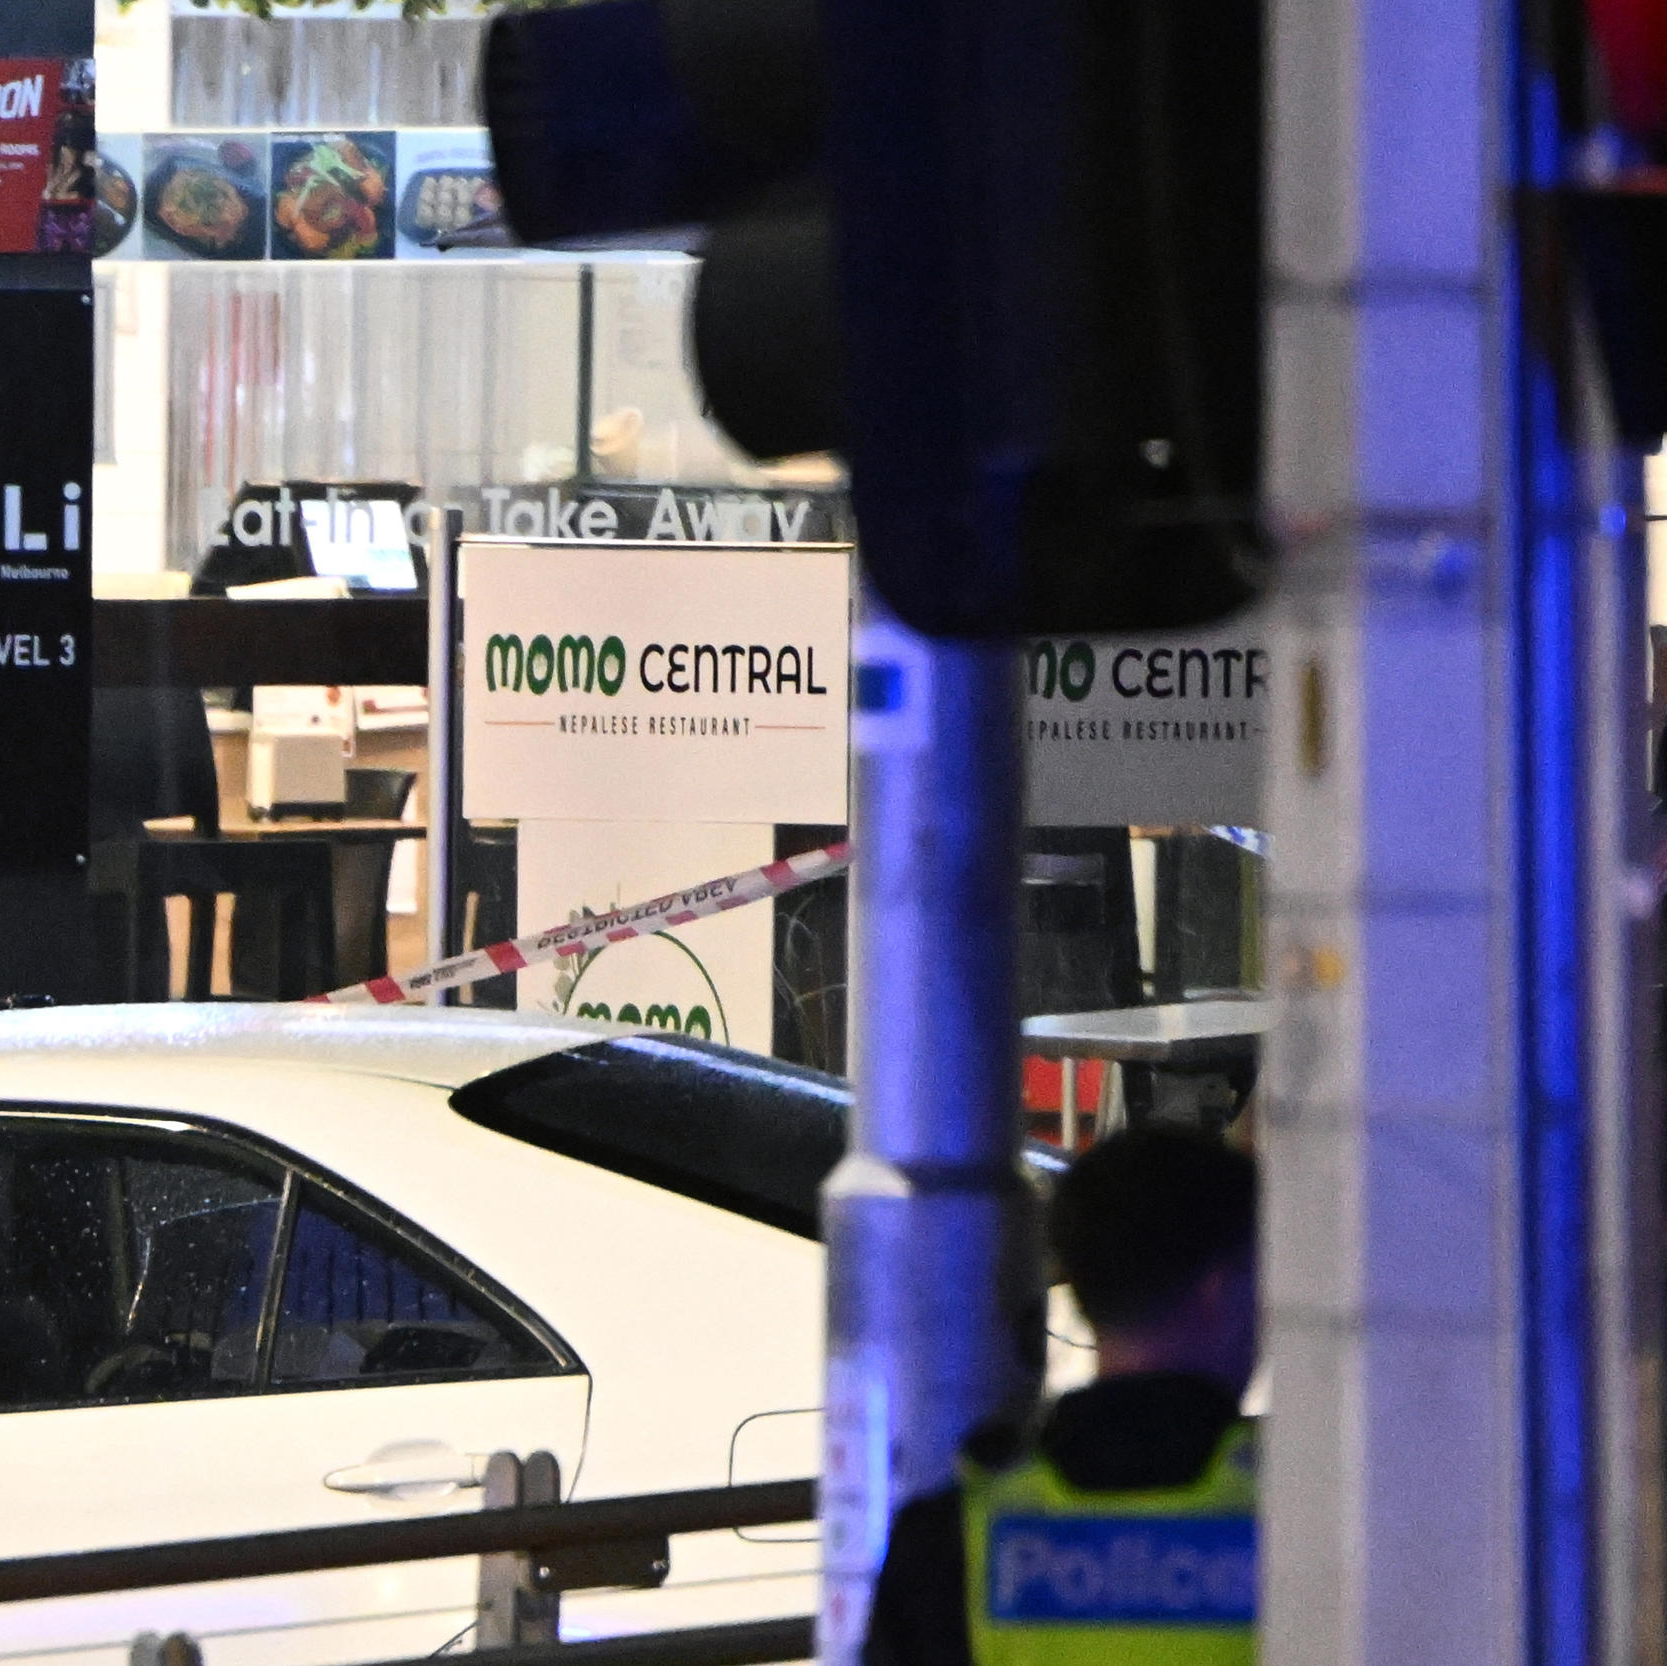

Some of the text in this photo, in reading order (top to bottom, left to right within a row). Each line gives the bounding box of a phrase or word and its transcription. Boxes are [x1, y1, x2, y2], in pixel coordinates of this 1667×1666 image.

[481, 487, 617, 540] Take
[645, 487, 811, 544] Away
[59, 633, 76, 667] 3
[559, 715, 751, 738] NEPALESE RESTAURANT
